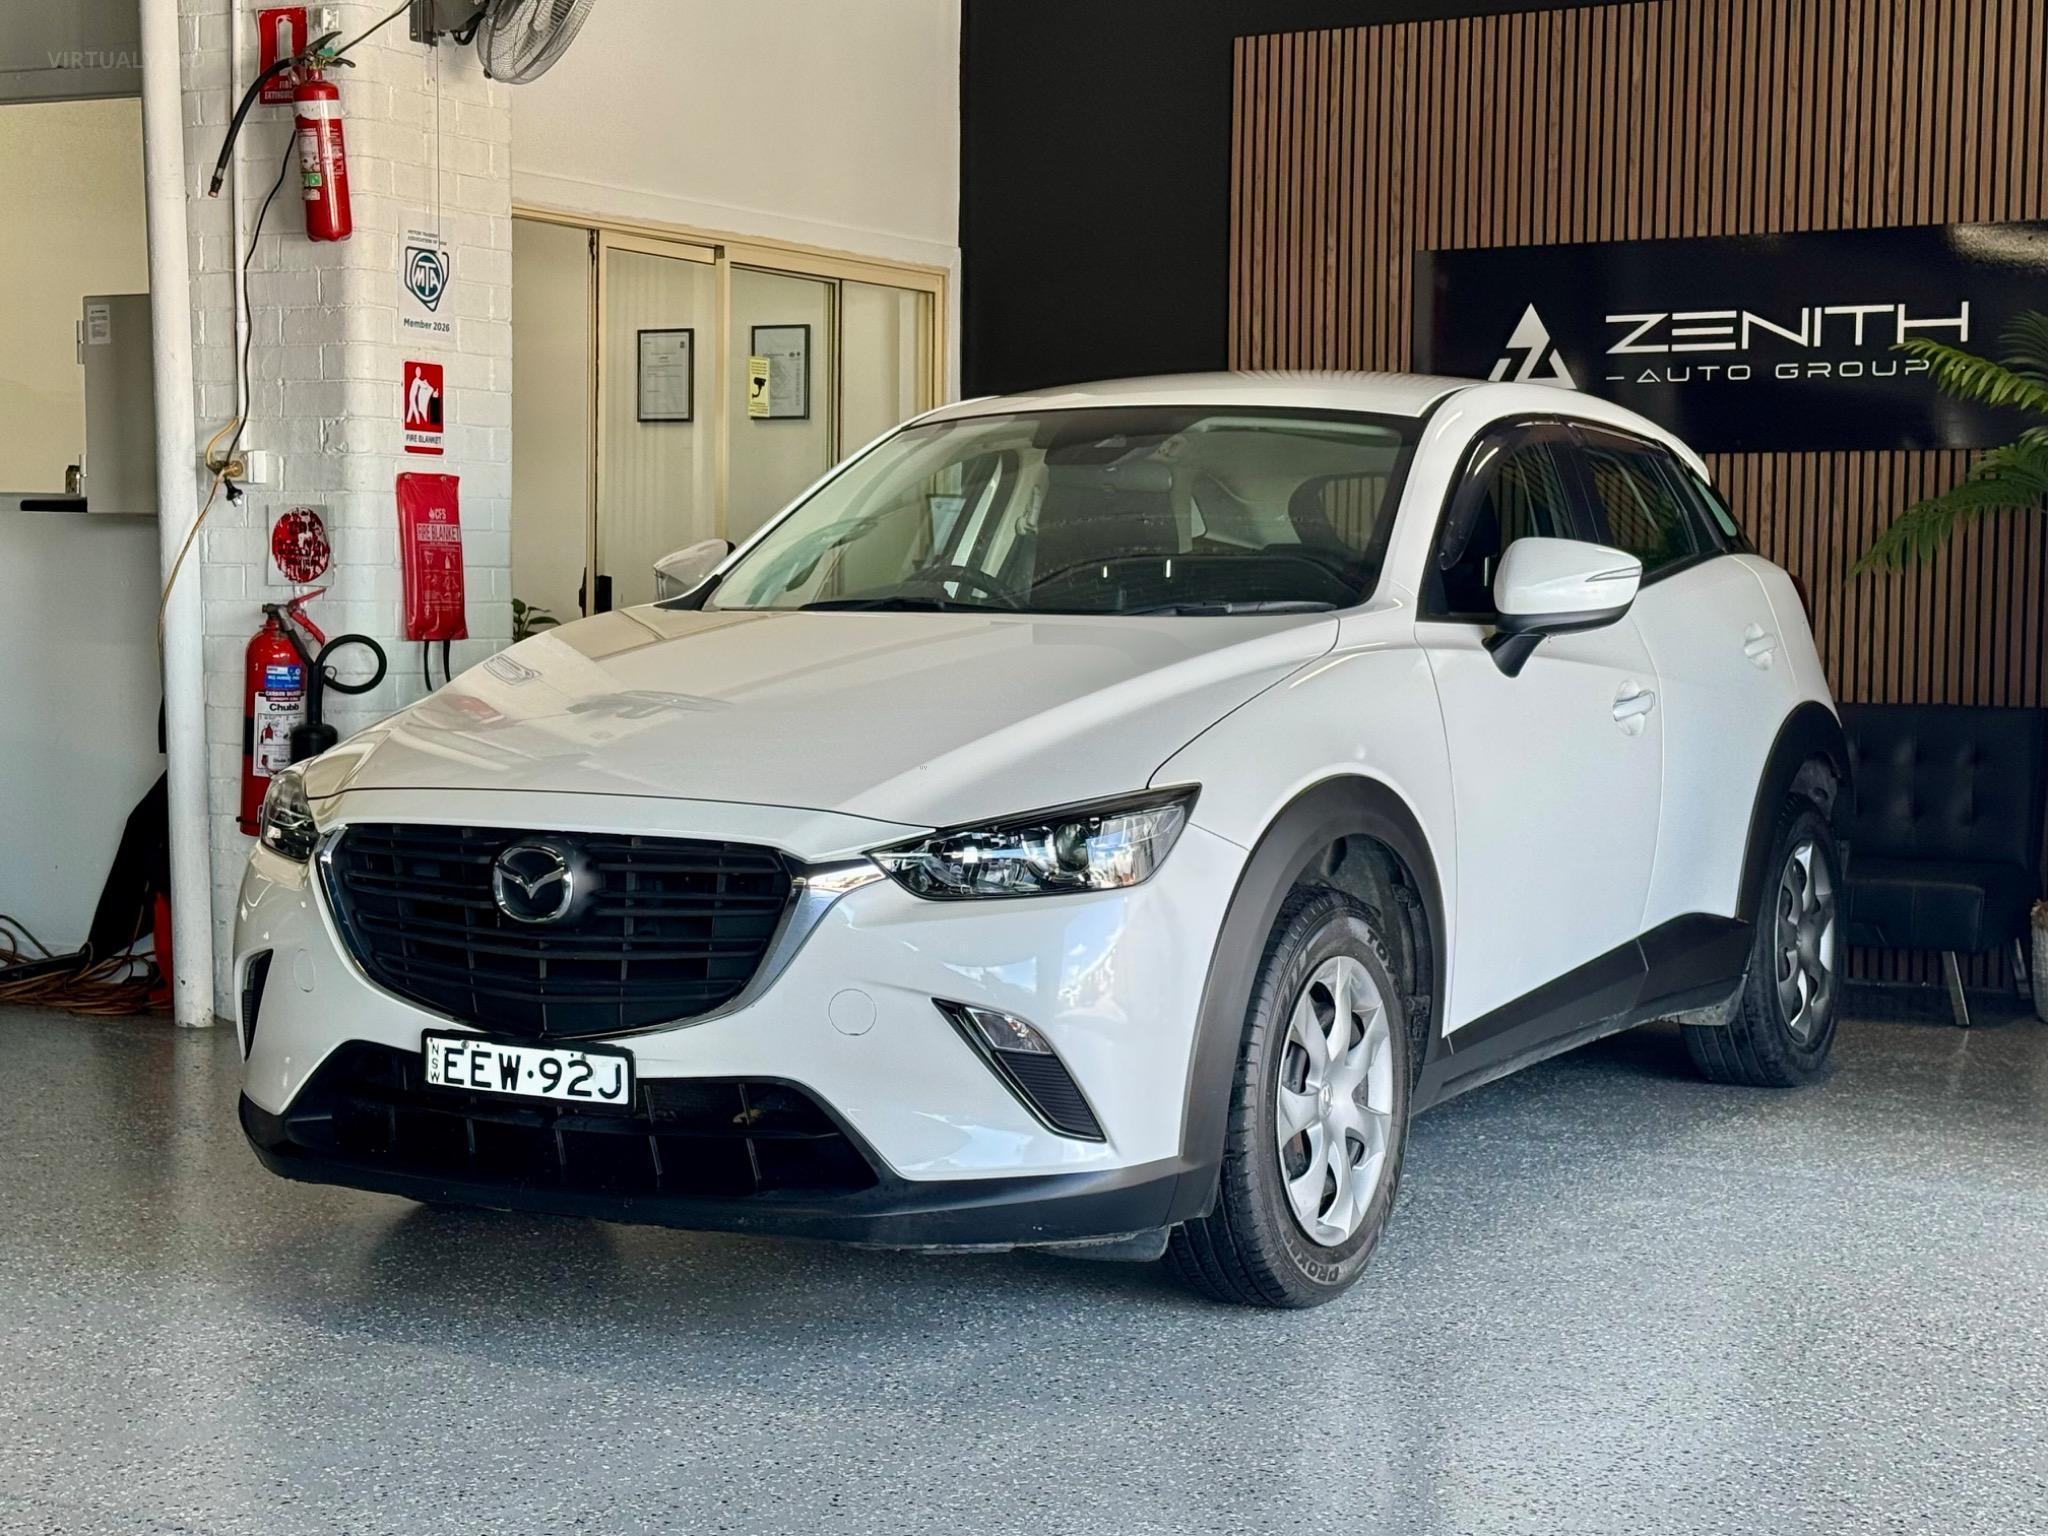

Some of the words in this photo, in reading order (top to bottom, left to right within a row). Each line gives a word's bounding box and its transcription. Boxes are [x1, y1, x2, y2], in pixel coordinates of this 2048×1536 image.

[403, 318, 431, 330] Member
[433, 322, 450, 332] 2026
[1605, 301, 1969, 354] ZENITH
[1636, 365, 1751, 384] AUTO
[1775, 359, 1930, 380] GROUP
[269, 703, 300, 712] Chubb
[430, 1043, 440, 1083] NSW
